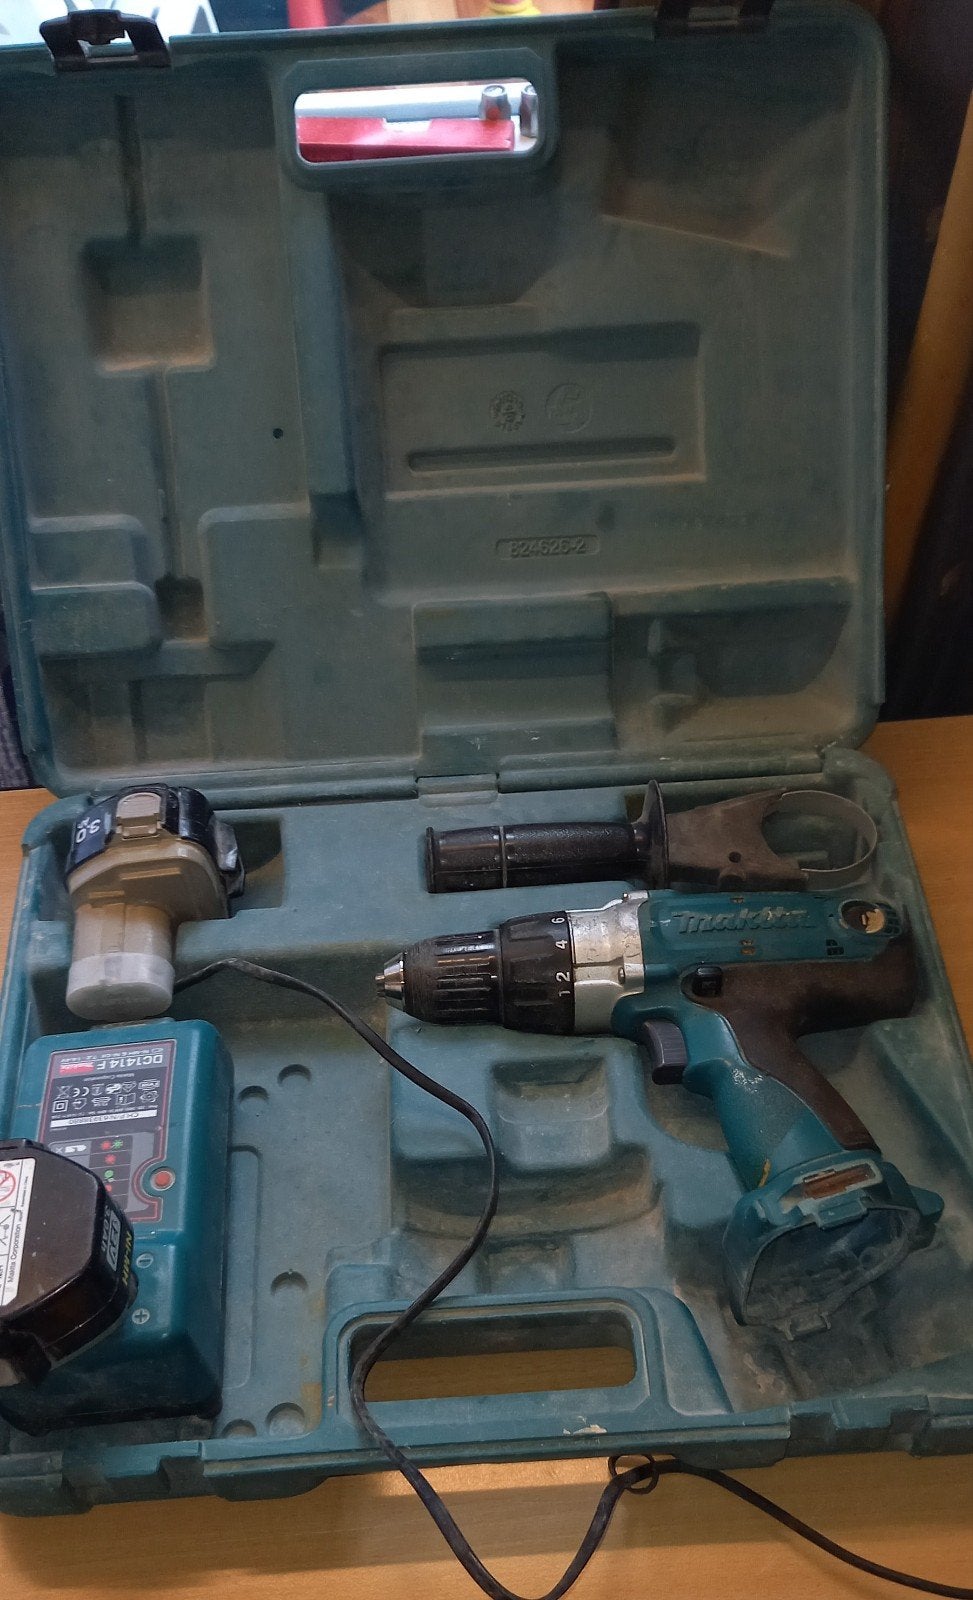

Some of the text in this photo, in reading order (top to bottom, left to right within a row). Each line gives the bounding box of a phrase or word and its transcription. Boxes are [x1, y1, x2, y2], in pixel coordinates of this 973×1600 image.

[76, 819, 101, 843] 3.0
[555, 939, 568, 950] 4
[555, 971, 571, 982] 2
[7, 1223, 21, 1283] Makita Corporation
